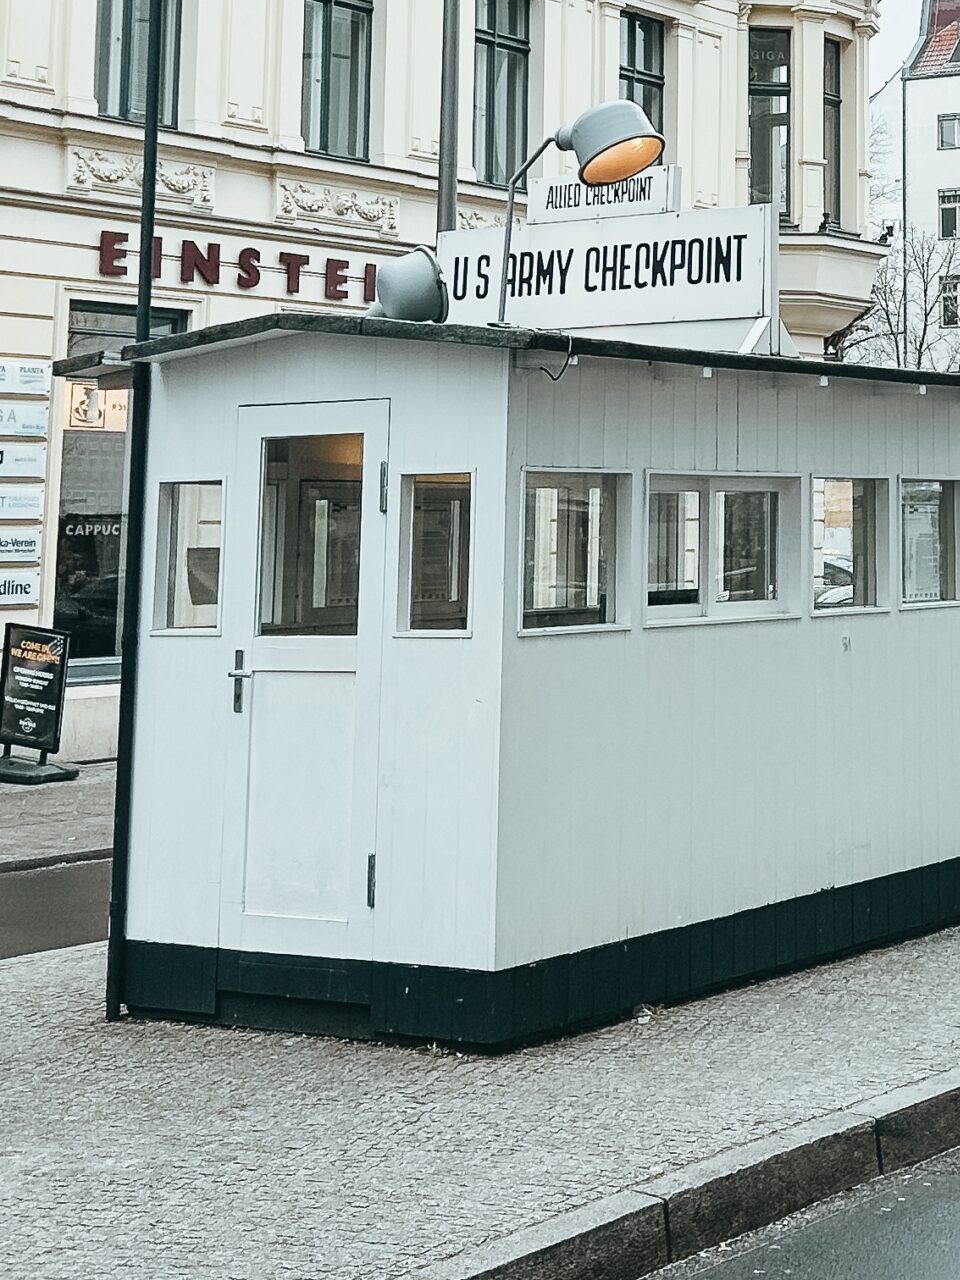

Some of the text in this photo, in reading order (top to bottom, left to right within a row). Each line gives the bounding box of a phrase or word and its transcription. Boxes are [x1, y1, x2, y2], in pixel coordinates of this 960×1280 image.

[546, 176, 653, 210] ALLIED CHECKPOINT
[506, 248, 575, 297] ARMY
[584, 234, 747, 293] CHECKPOINT
